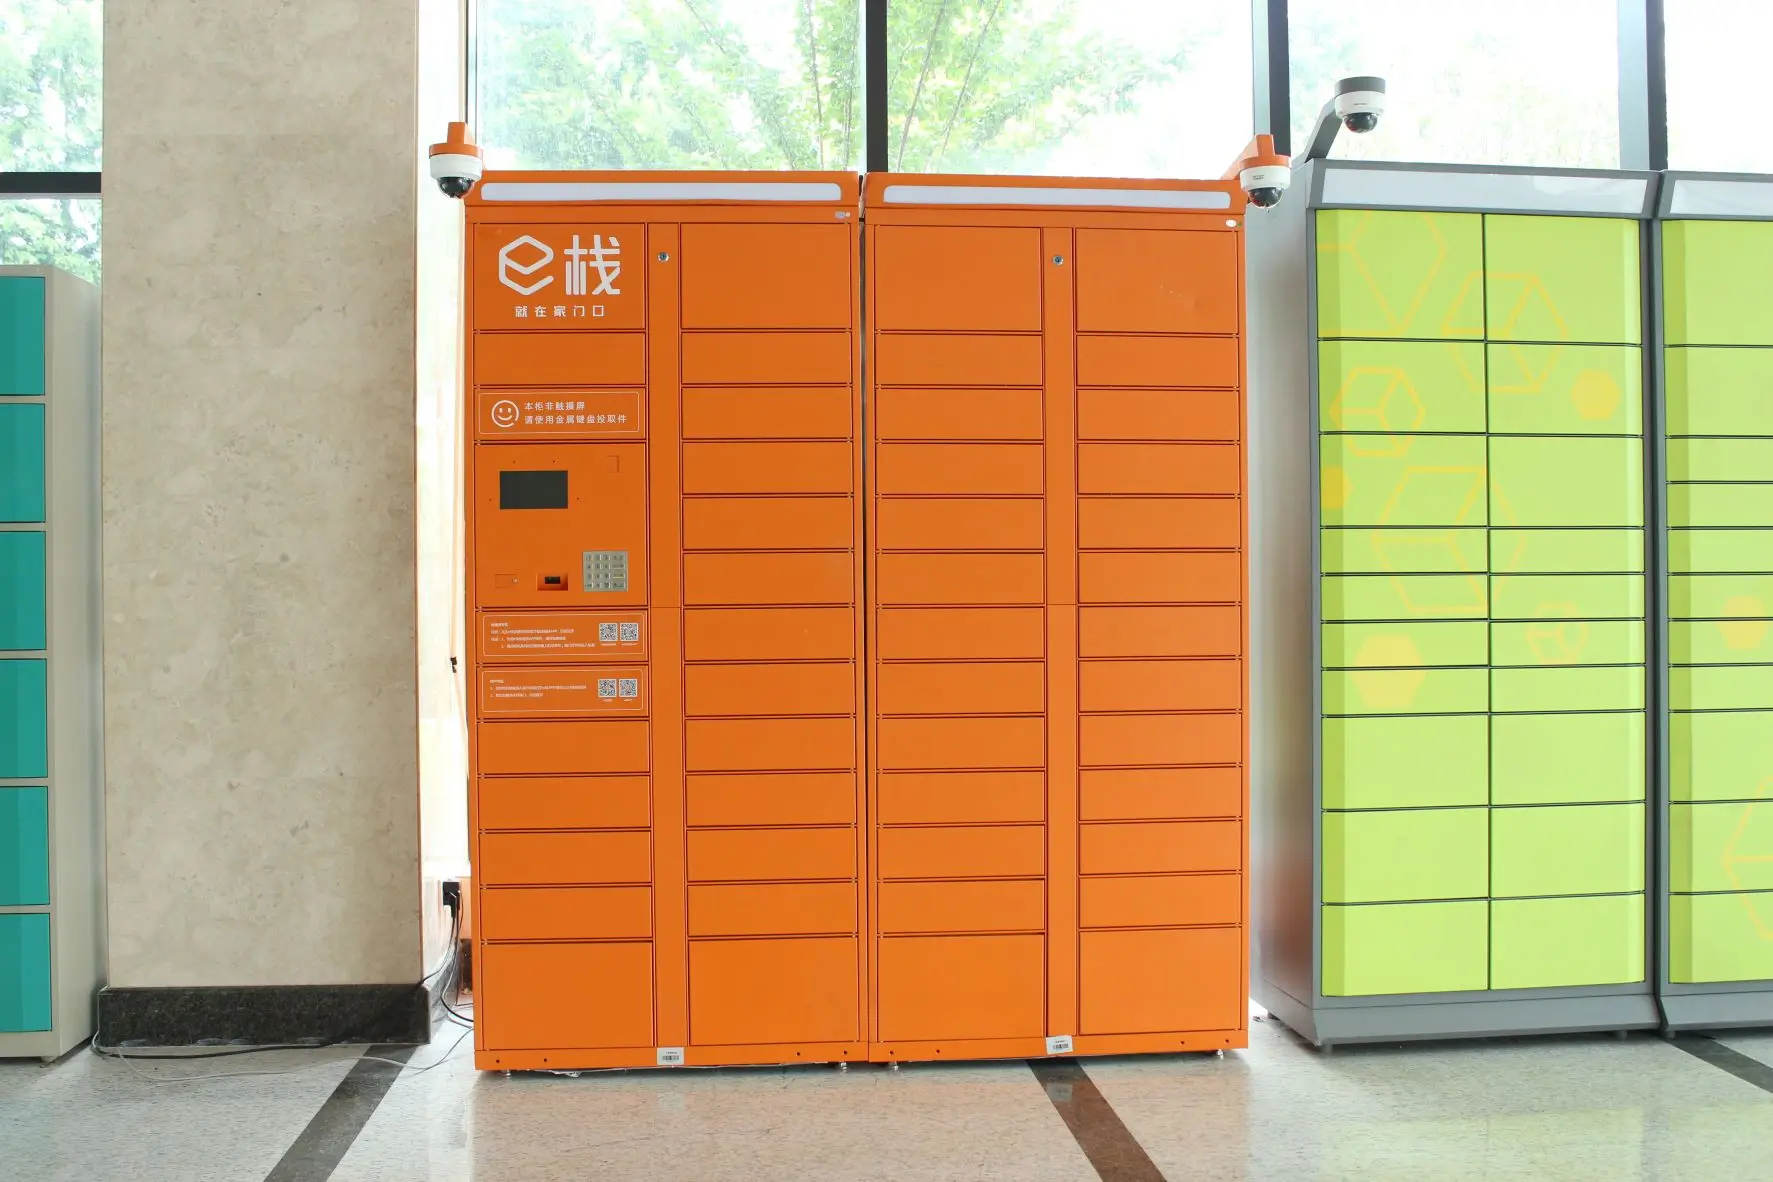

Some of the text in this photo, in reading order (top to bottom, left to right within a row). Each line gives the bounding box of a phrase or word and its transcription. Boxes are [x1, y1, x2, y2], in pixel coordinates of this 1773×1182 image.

[514, 305, 605, 318] 就在家门口
[524, 401, 585, 411] 本柜非触摸屏
[524, 414, 627, 424] 请使用金属键盘投取件
